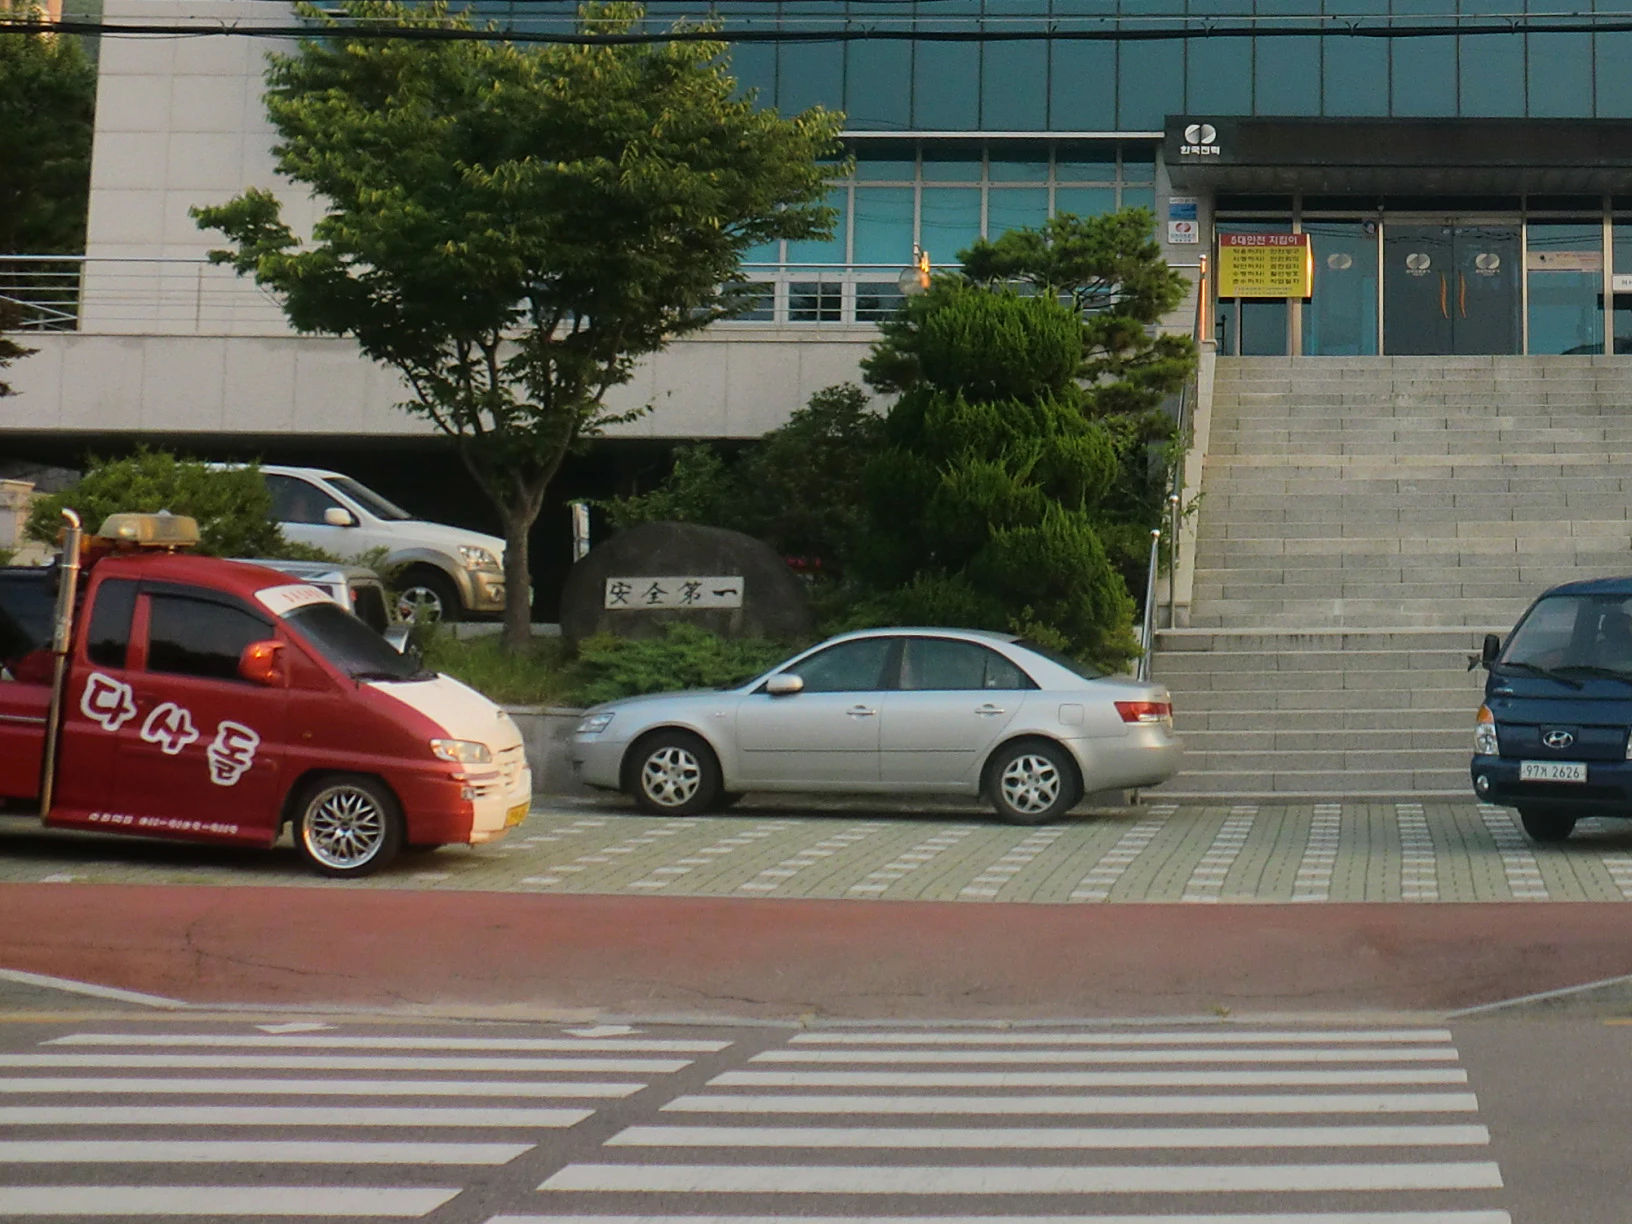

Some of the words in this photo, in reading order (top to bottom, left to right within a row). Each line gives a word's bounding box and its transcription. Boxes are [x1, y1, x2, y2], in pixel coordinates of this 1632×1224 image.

[1180, 145, 1220, 155] 한국전력
[1231, 235, 1265, 245] 5대안전
[1269, 235, 1297, 245] 지킴이
[610, 581, 738, 605] 安全第一
[1552, 766, 1580, 779] 2626
